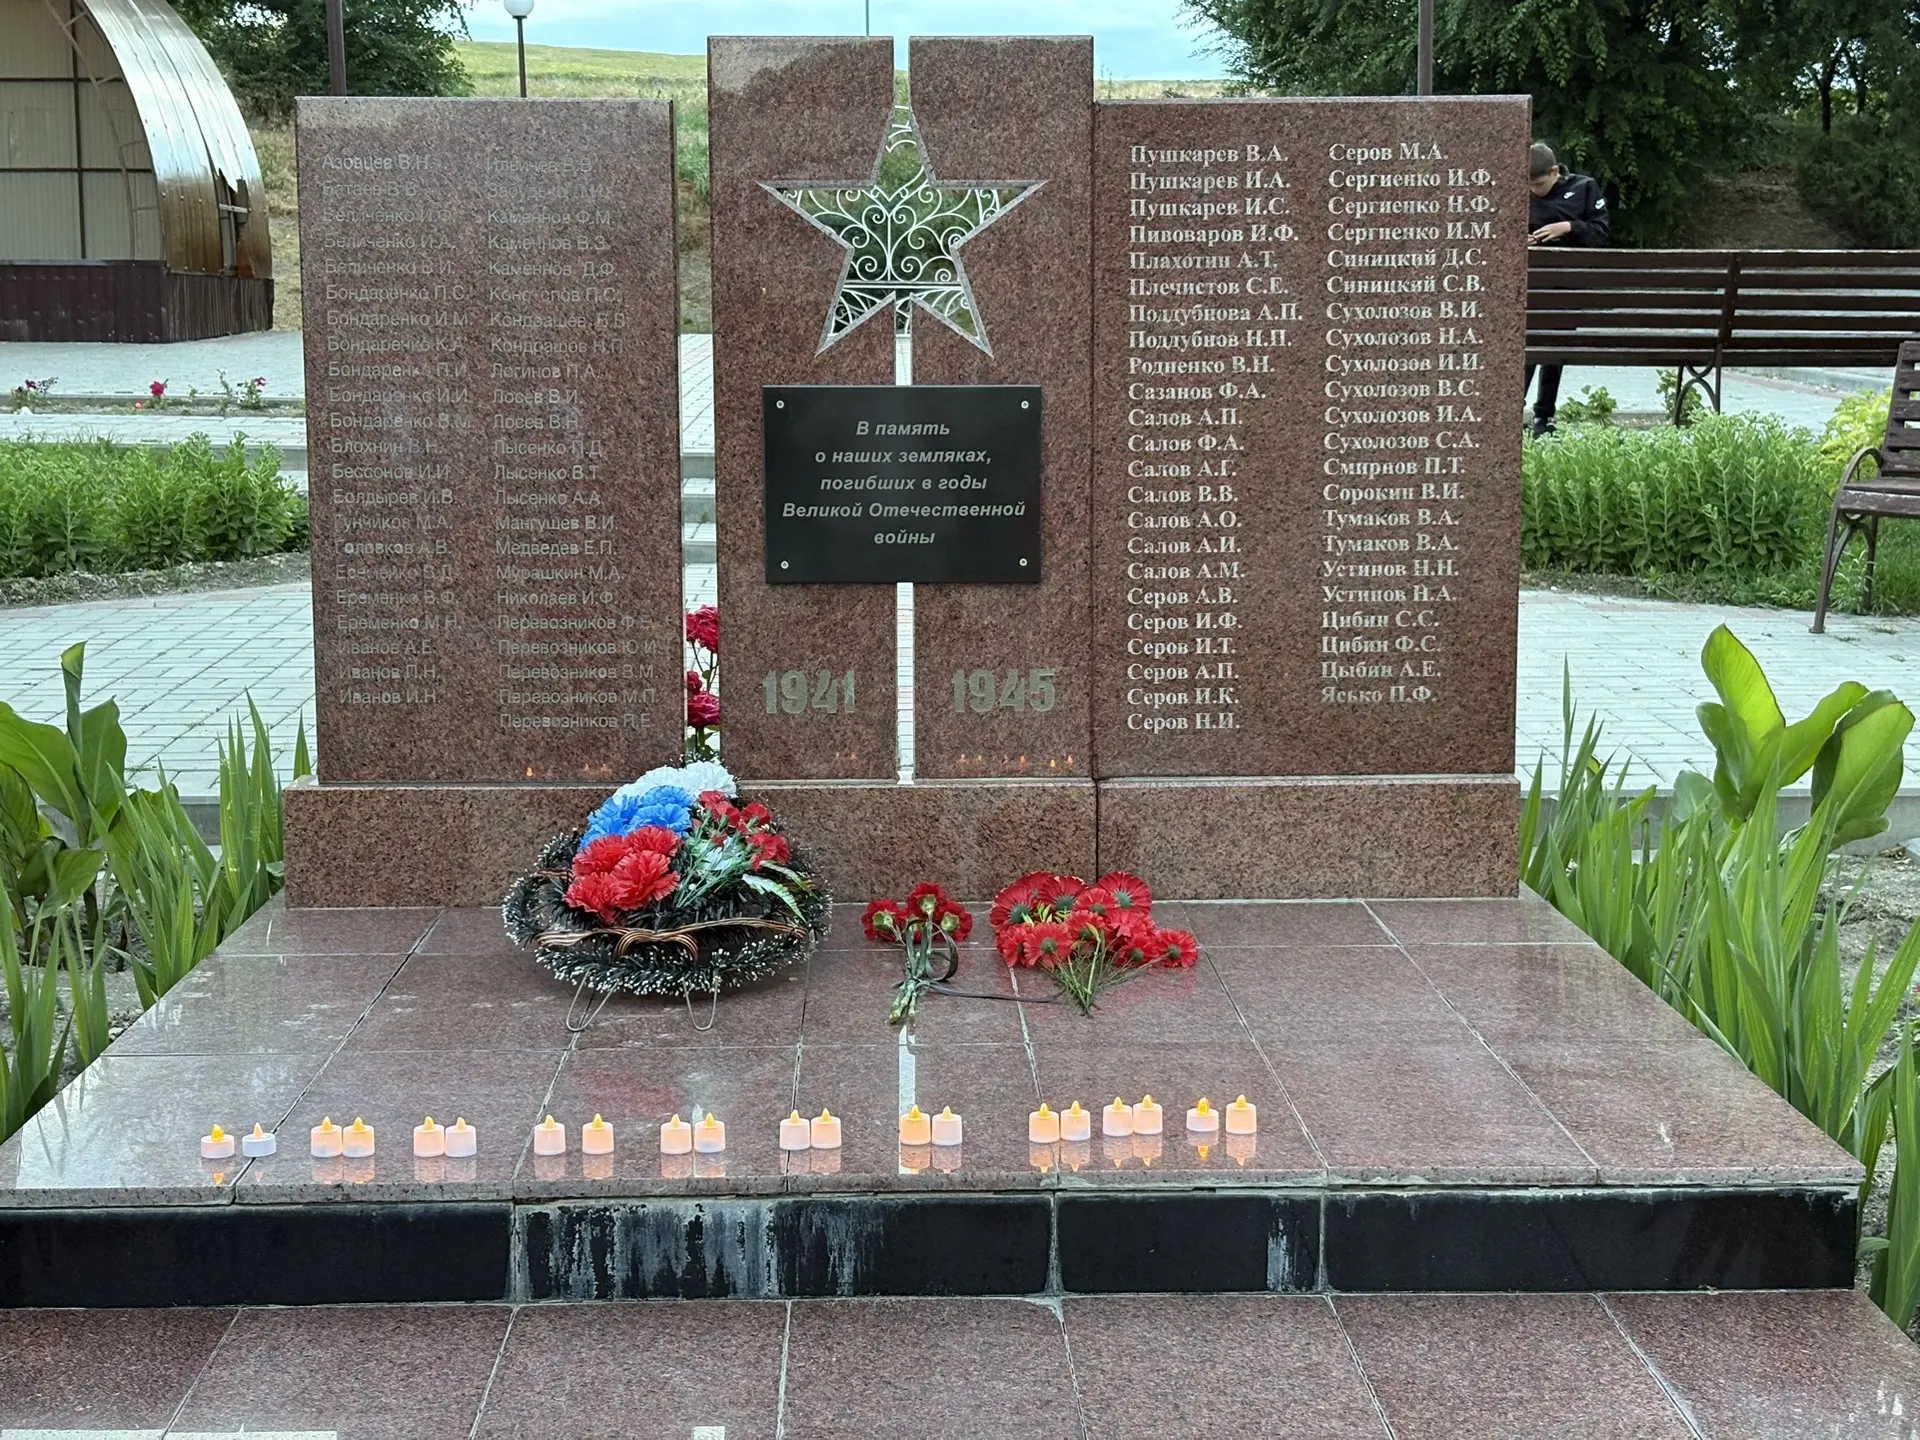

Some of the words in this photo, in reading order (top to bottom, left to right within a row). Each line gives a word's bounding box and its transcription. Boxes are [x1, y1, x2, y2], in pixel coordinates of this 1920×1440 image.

[1131, 146, 1238, 166] Пушкарев
[1246, 145, 1288, 162] В.А.
[1329, 144, 1392, 164] Серов
[1399, 143, 1448, 160] М.А.
[1130, 173, 1238, 193] Пушкарев
[1245, 172, 1290, 188] И.А.
[1328, 170, 1440, 190] Сергиенко
[1447, 169, 1496, 186] И.Ф.
[1130, 199, 1237, 219] Пушкарев
[1244, 198, 1290, 215] И.С.
[1328, 197, 1440, 217] Сергиенко
[1447, 196, 1496, 212] Н.Ф.
[1129, 226, 1243, 246] Пивоваров
[1251, 225, 1299, 242] И.Ф.
[1328, 223, 1439, 243] Сергиенко
[1446, 222, 1496, 239] И.М.
[1129, 252, 1230, 269] Плахотин
[1238, 251, 1278, 267] А.Т.
[1327, 249, 1436, 268] Синицкий
[1442, 249, 1487, 268] Д.С.
[1129, 278, 1239, 295] Плечистов
[1246, 277, 1288, 294] С.Е.
[1327, 276, 1435, 295] Синицкий
[1443, 275, 1485, 292] С.В.
[1129, 305, 1250, 325] Поддубнова
[1257, 304, 1303, 320] А.П.
[1326, 302, 1433, 322] Сухолозов
[1439, 302, 1483, 318] В.И.
[1129, 331, 1238, 351] Поддубнов
[1246, 330, 1291, 347] Н.П.
[1326, 328, 1431, 349] Сухолозов
[1439, 328, 1483, 344] Н.А.
[1325, 354, 1431, 374] Сухолозов
[1128, 383, 1212, 400] Сазанов
[1219, 382, 1266, 399] Ф.А.
[1325, 380, 1430, 401] Сухолозов
[1437, 380, 1479, 396] В.С.
[1128, 409, 1191, 426] Салов
[1198, 408, 1242, 425] А.П.
[1324, 406, 1429, 426] Сухолозов
[1436, 405, 1482, 422] И.А.
[856, 422, 869, 435] В
[875, 424, 950, 435] память
[1128, 434, 1191, 451] Салов
[1198, 433, 1244, 450] Ф.А.
[1324, 432, 1429, 453] Сухолозов
[1436, 432, 1479, 448] С.А.
[815, 451, 826, 462] о
[832, 451, 892, 462] наших
[898, 451, 991, 465] земляках,
[1128, 460, 1190, 477] Салов
[1197, 460, 1237, 476] А.Г.
[1324, 458, 1417, 478] Смирнов
[1424, 457, 1465, 474] П.Т.
[820, 475, 915, 489] погибших
[922, 478, 932, 489] в
[938, 476, 987, 489] годы
[1127, 486, 1190, 503] Салов
[1198, 485, 1238, 501] В.В.
[1323, 484, 1414, 504] Сорокин
[1421, 483, 1464, 500] В.И.
[782, 503, 862, 517] Великой
[869, 502, 1025, 517] Отечественной
[1127, 511, 1190, 528] Салов
[1198, 510, 1242, 527] А.О.
[1323, 510, 1410, 530] Тумаков
[1417, 509, 1459, 526] В.А.
[874, 529, 935, 544] войны
[1127, 537, 1190, 554] Салов
[1196, 536, 1241, 553] А.И.
[1323, 535, 1409, 555] Тумаков
[1416, 534, 1458, 551] В.А.
[1127, 562, 1190, 579] Салов
[1196, 561, 1245, 578] А.М.
[1323, 560, 1406, 577] Устинов
[1127, 587, 1188, 608] Серов
[1195, 587, 1237, 603] А.В.
[1323, 585, 1406, 602] Устинов
[1412, 585, 1456, 601] Н.А.
[1127, 613, 1188, 633] Серов
[1196, 612, 1242, 629] И.Ф.
[1322, 610, 1388, 630] Цибин
[1395, 610, 1439, 626] С.С.
[1127, 638, 1188, 658] Серов
[1196, 637, 1236, 654] И.Т.
[1322, 636, 1388, 656] Цибин
[1395, 635, 1441, 652] Ф.С.
[1127, 663, 1188, 683] Серов
[1195, 662, 1239, 679] А.П.
[1321, 661, 1392, 681] Цыбин
[1400, 660, 1441, 676] А.Е.
[762, 670, 855, 714] 1941
[951, 668, 1056, 713] 1945
[1127, 688, 1188, 708] Серов
[1196, 687, 1239, 704] И.К.
[1321, 685, 1383, 702] Ясько
[1127, 713, 1188, 733] Серов
[1195, 712, 1240, 728] Н.И.
